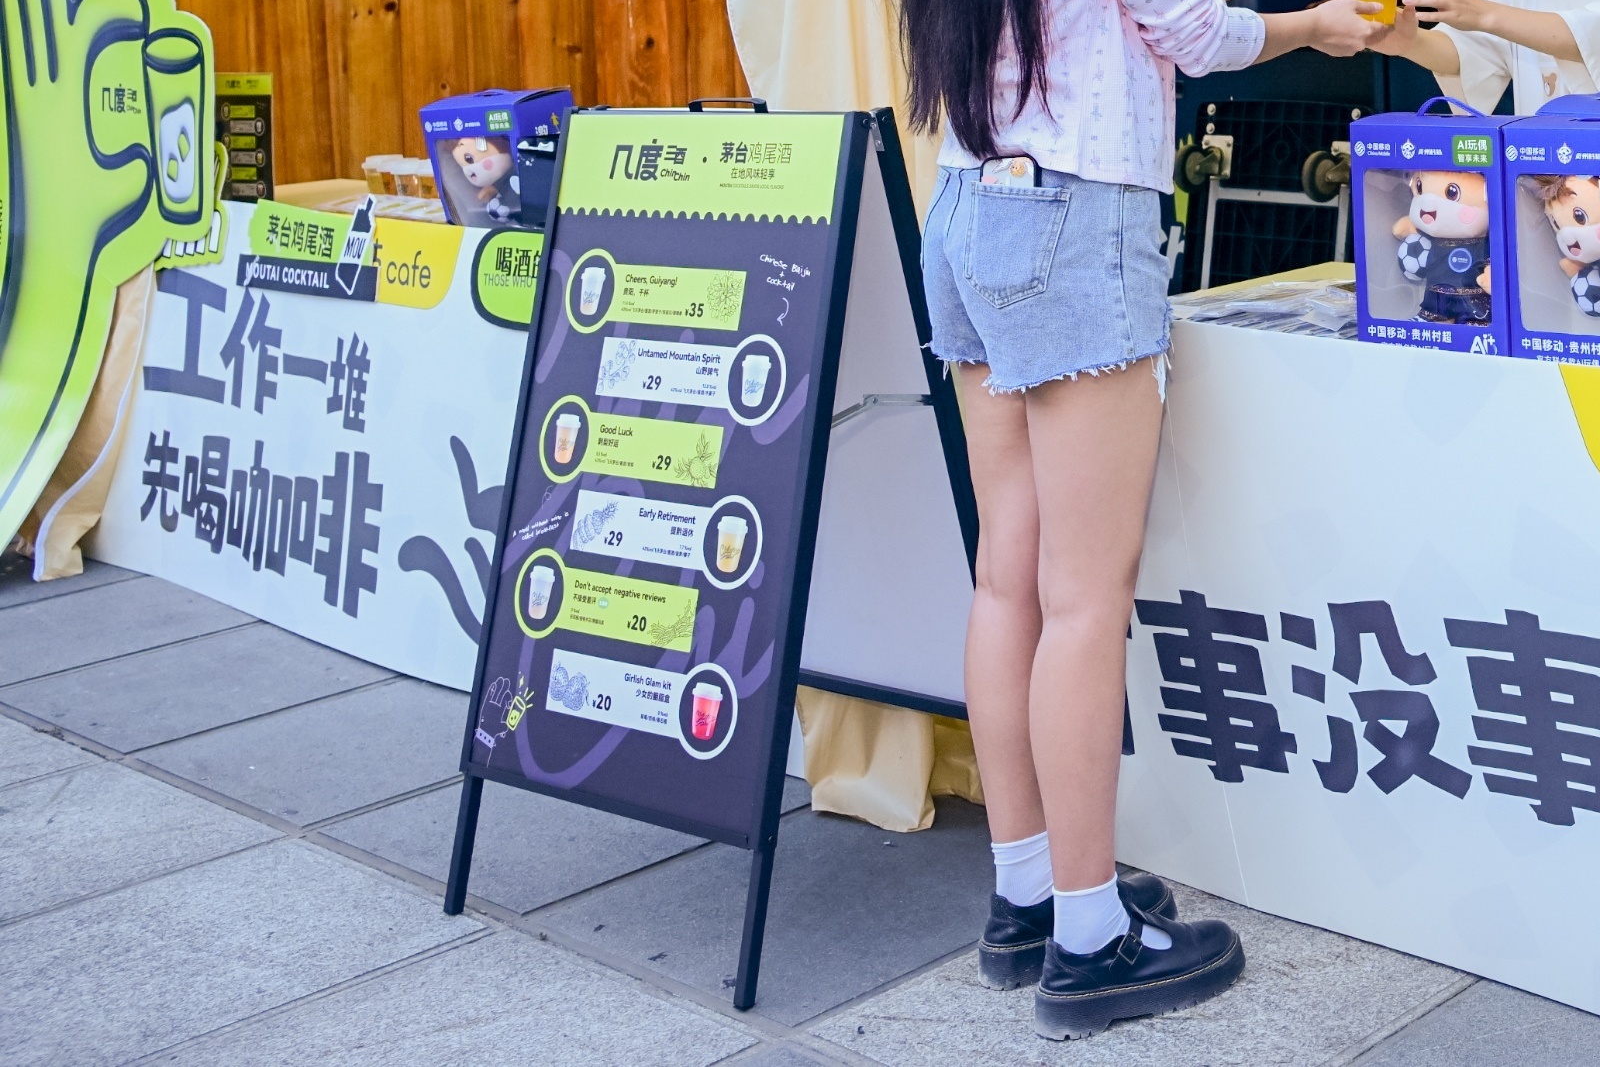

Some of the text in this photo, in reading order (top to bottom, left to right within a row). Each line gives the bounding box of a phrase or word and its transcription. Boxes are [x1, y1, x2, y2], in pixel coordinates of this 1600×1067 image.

[719, 141, 793, 164] 茅台鸡尾酒
[1367, 142, 1391, 151] 中国移动
[1457, 139, 1487, 151] AI玩偶
[1519, 147, 1546, 155] 中国移动
[1457, 153, 1488, 163] 智享未来
[730, 167, 776, 180] 在地风味轻享
[266, 215, 335, 259] 茅台鸡尾酒
[345, 236, 366, 258] MOU
[386, 250, 431, 289] cafe
[760, 254, 788, 270] Chinese
[246, 262, 330, 289] MOUTAI COCKTAIL
[483, 273, 533, 288] THOSE WHO
[625, 274, 678, 288] Cheers, Guiyang!
[685, 302, 704, 318] ¥35
[1367, 324, 1453, 344] 中国移动·贵州村超
[143, 270, 371, 433] 工作一堆
[637, 348, 721, 365] Untamed Mountain Spirit
[642, 375, 662, 390] ¥29
[600, 424, 633, 437] Good Luck
[652, 455, 671, 471] ¥29
[140, 430, 384, 619] 先喝咖啡
[639, 507, 696, 525] Early Retirement
[604, 530, 623, 546] ¥29
[574, 580, 666, 603] Don't accept negative reviews
[627, 615, 647, 632] ¥20
[624, 673, 672, 690] Girlish Glam kit
[592, 694, 612, 711] ¥20
